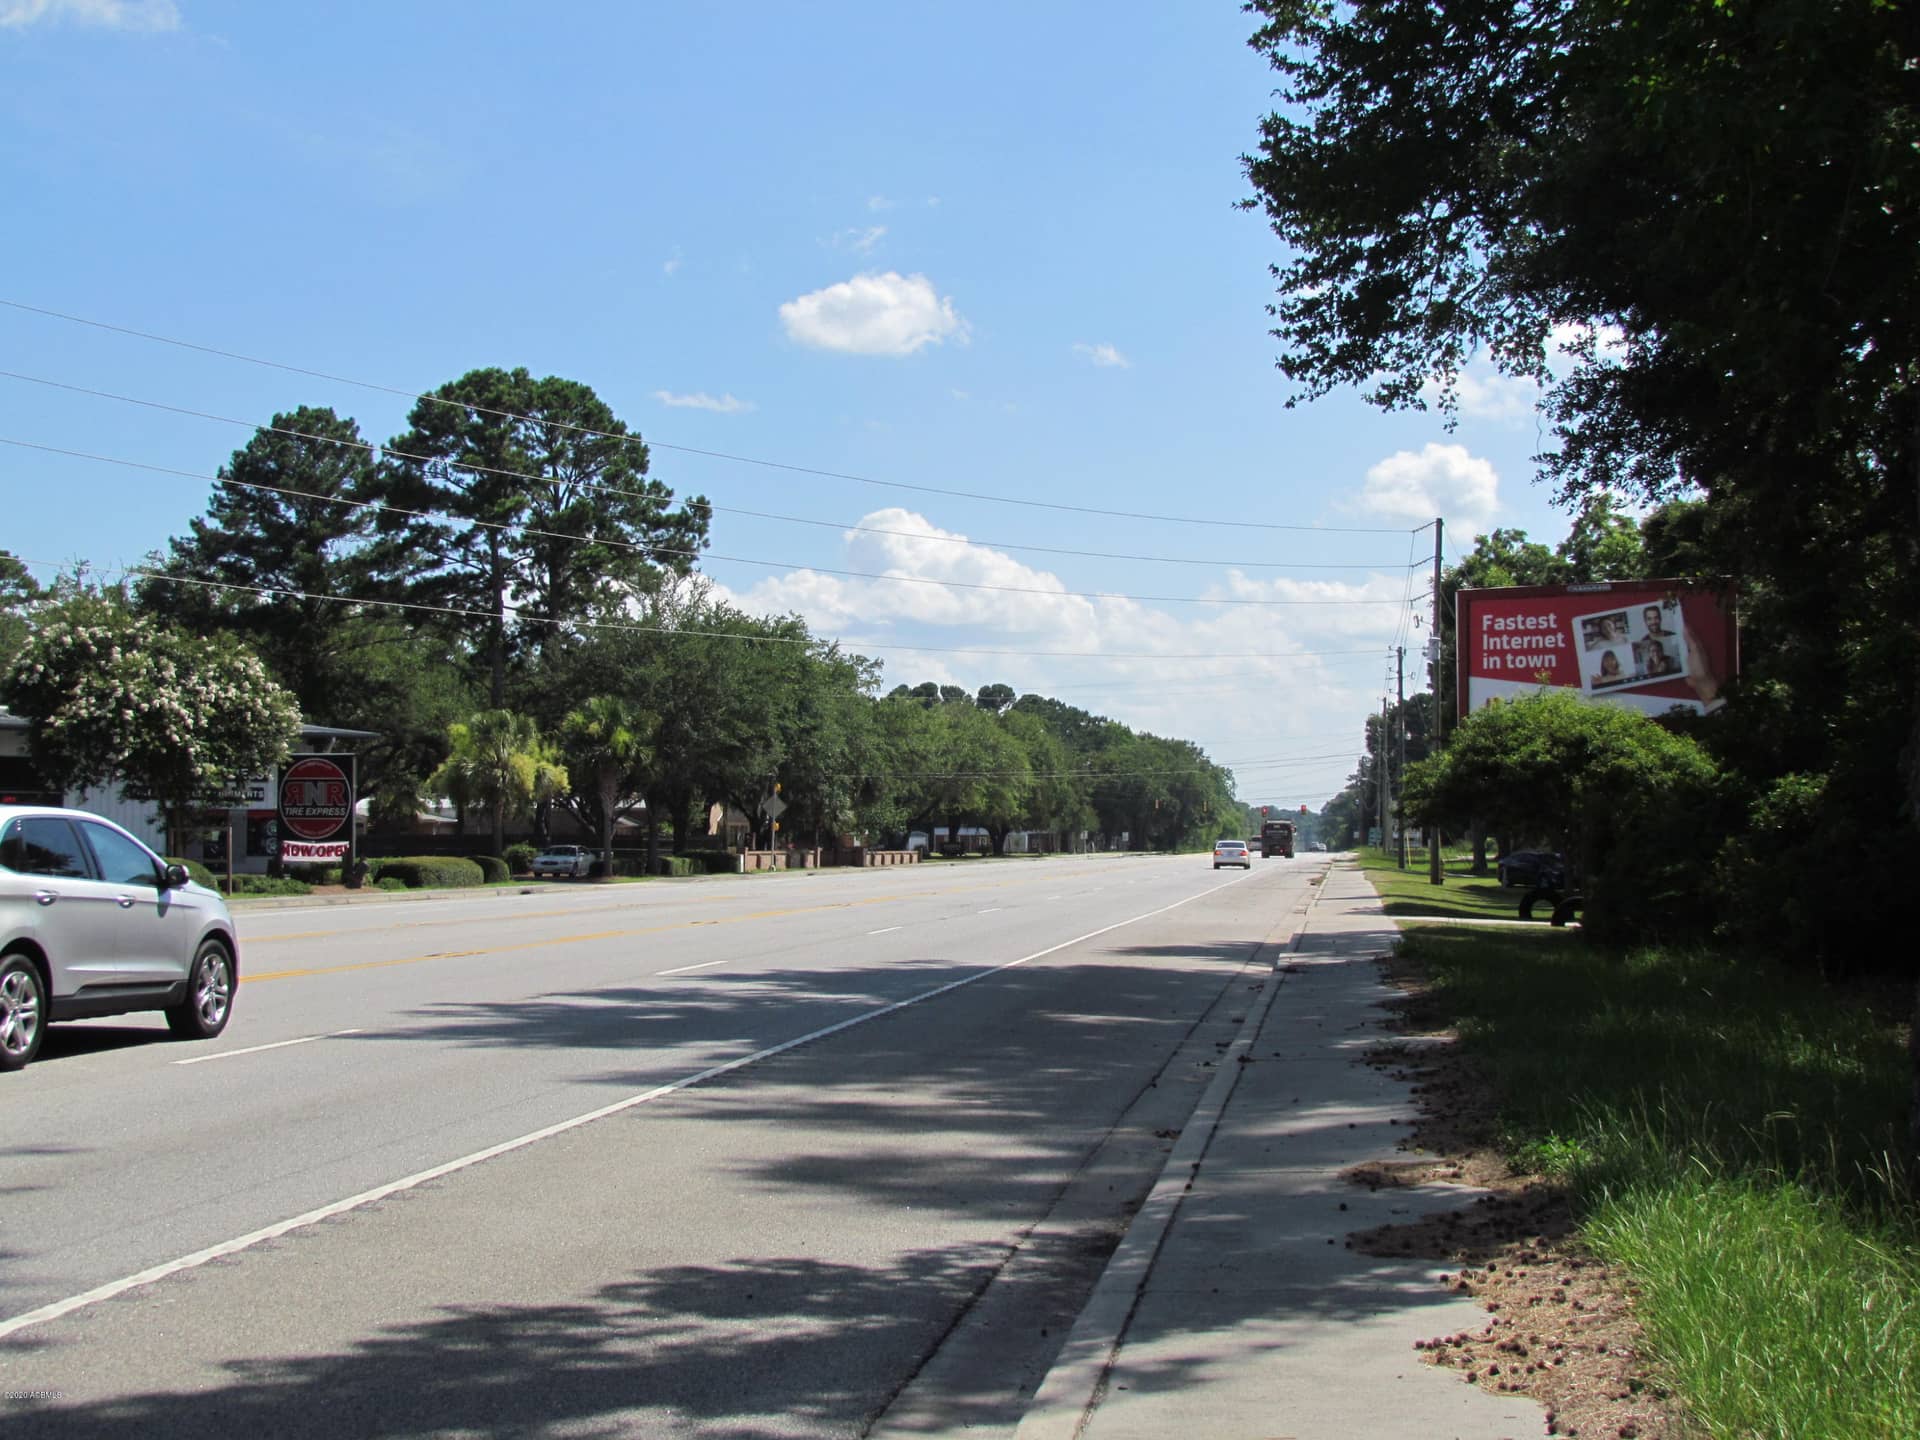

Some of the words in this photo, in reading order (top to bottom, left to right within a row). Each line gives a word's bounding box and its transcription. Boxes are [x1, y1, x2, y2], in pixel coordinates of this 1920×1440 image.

[1482, 612, 1558, 631] Fastest
[1482, 632, 1566, 651] Internet
[1482, 652, 1501, 670] in
[1505, 652, 1557, 669] town
[284, 807, 305, 816] TIRE
[305, 807, 346, 816] EXPRESS
[281, 843, 313, 857] NOW
